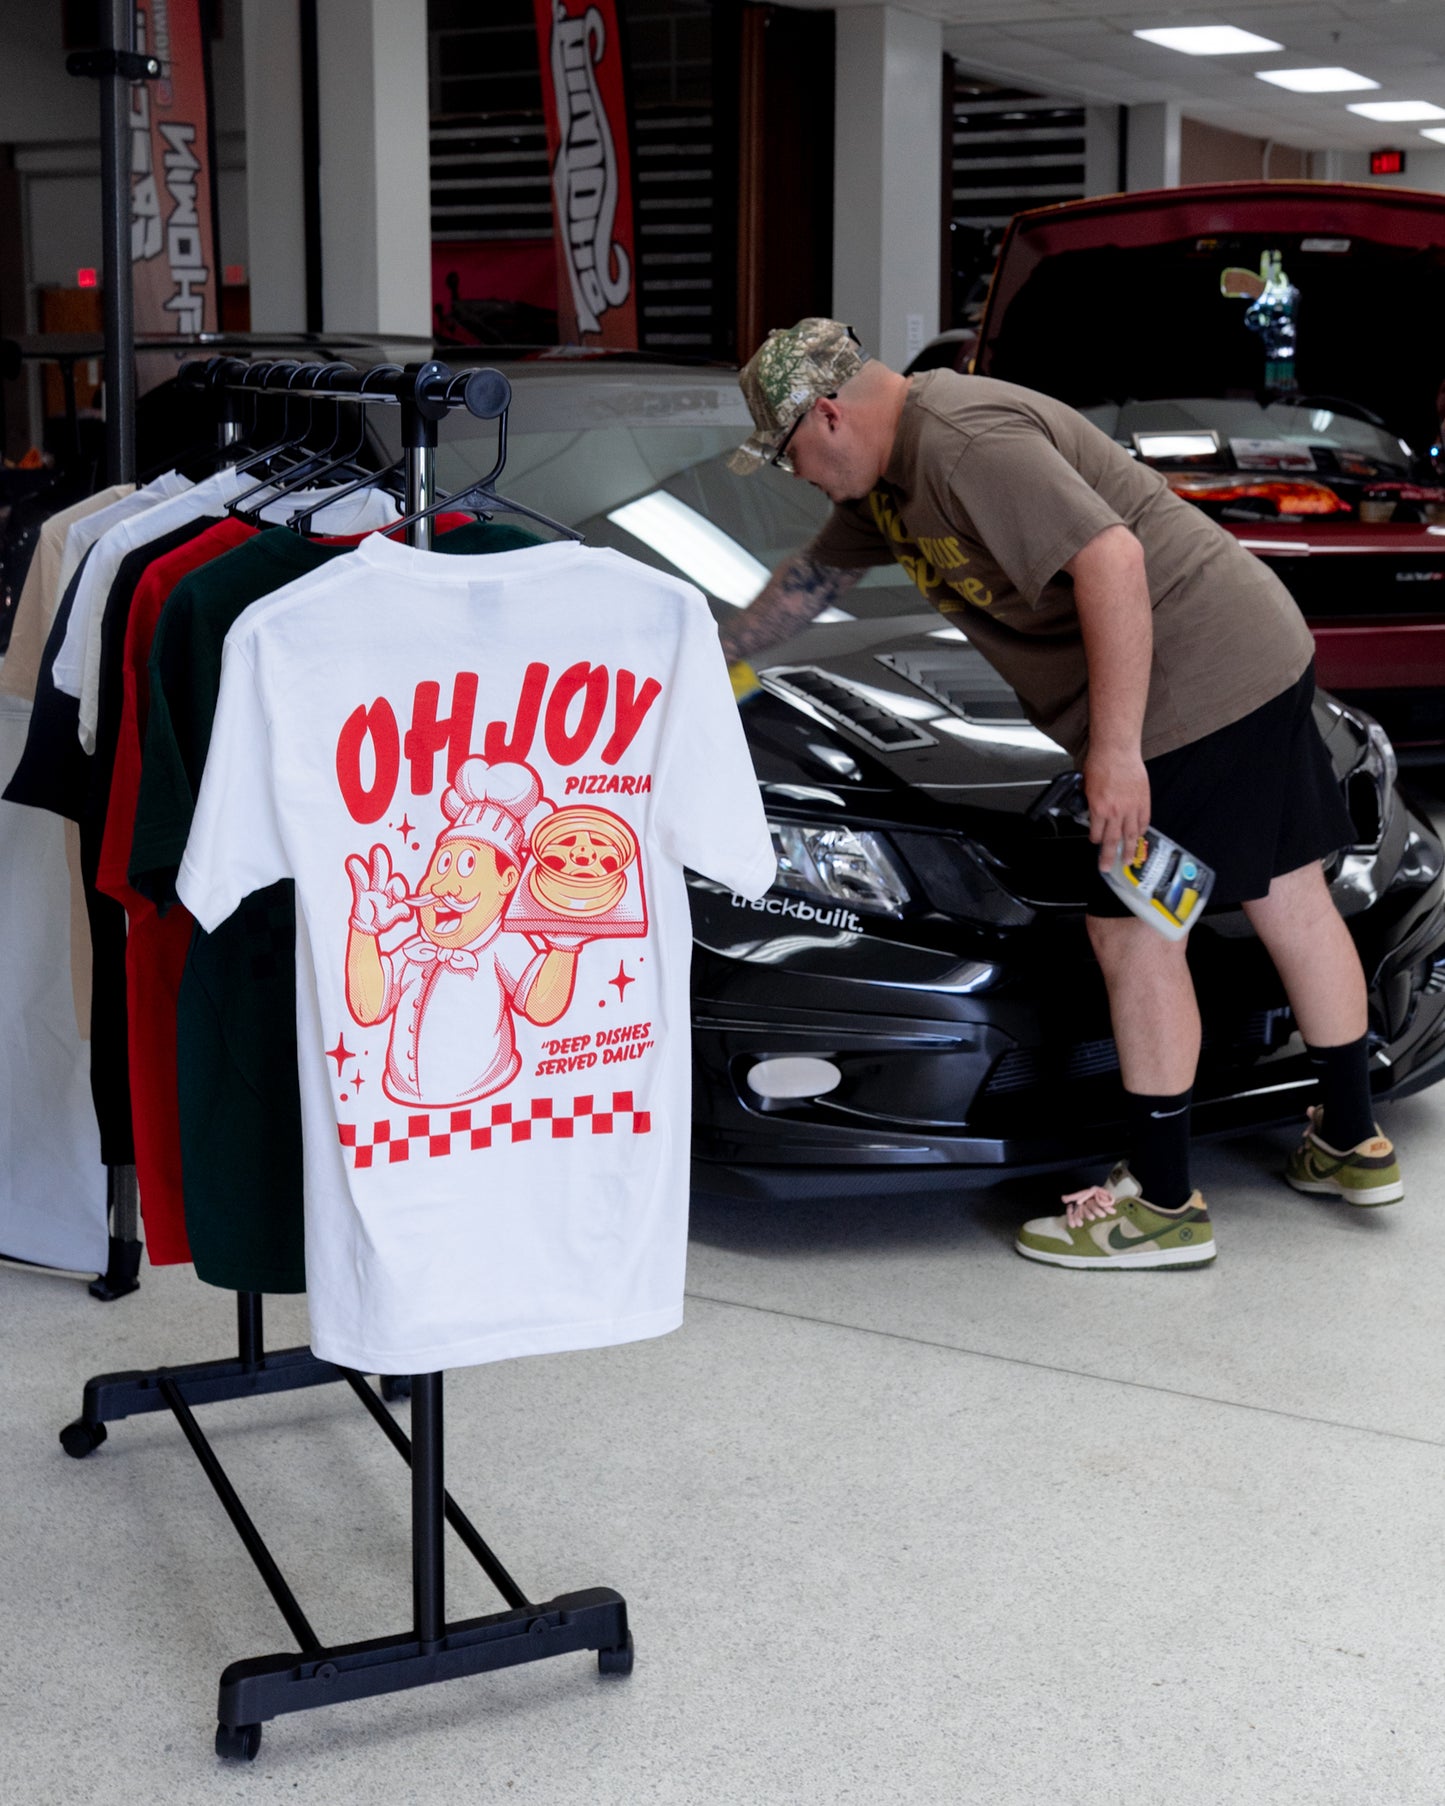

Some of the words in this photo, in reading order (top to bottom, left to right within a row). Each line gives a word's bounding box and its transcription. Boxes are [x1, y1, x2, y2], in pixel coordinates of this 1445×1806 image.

[336, 672, 478, 824] OH
[485, 661, 662, 767] JOY
[565, 774, 651, 796] PIZZARIA
[595, 1022, 651, 1048] DISHES
[535, 1052, 598, 1076] SERVED
